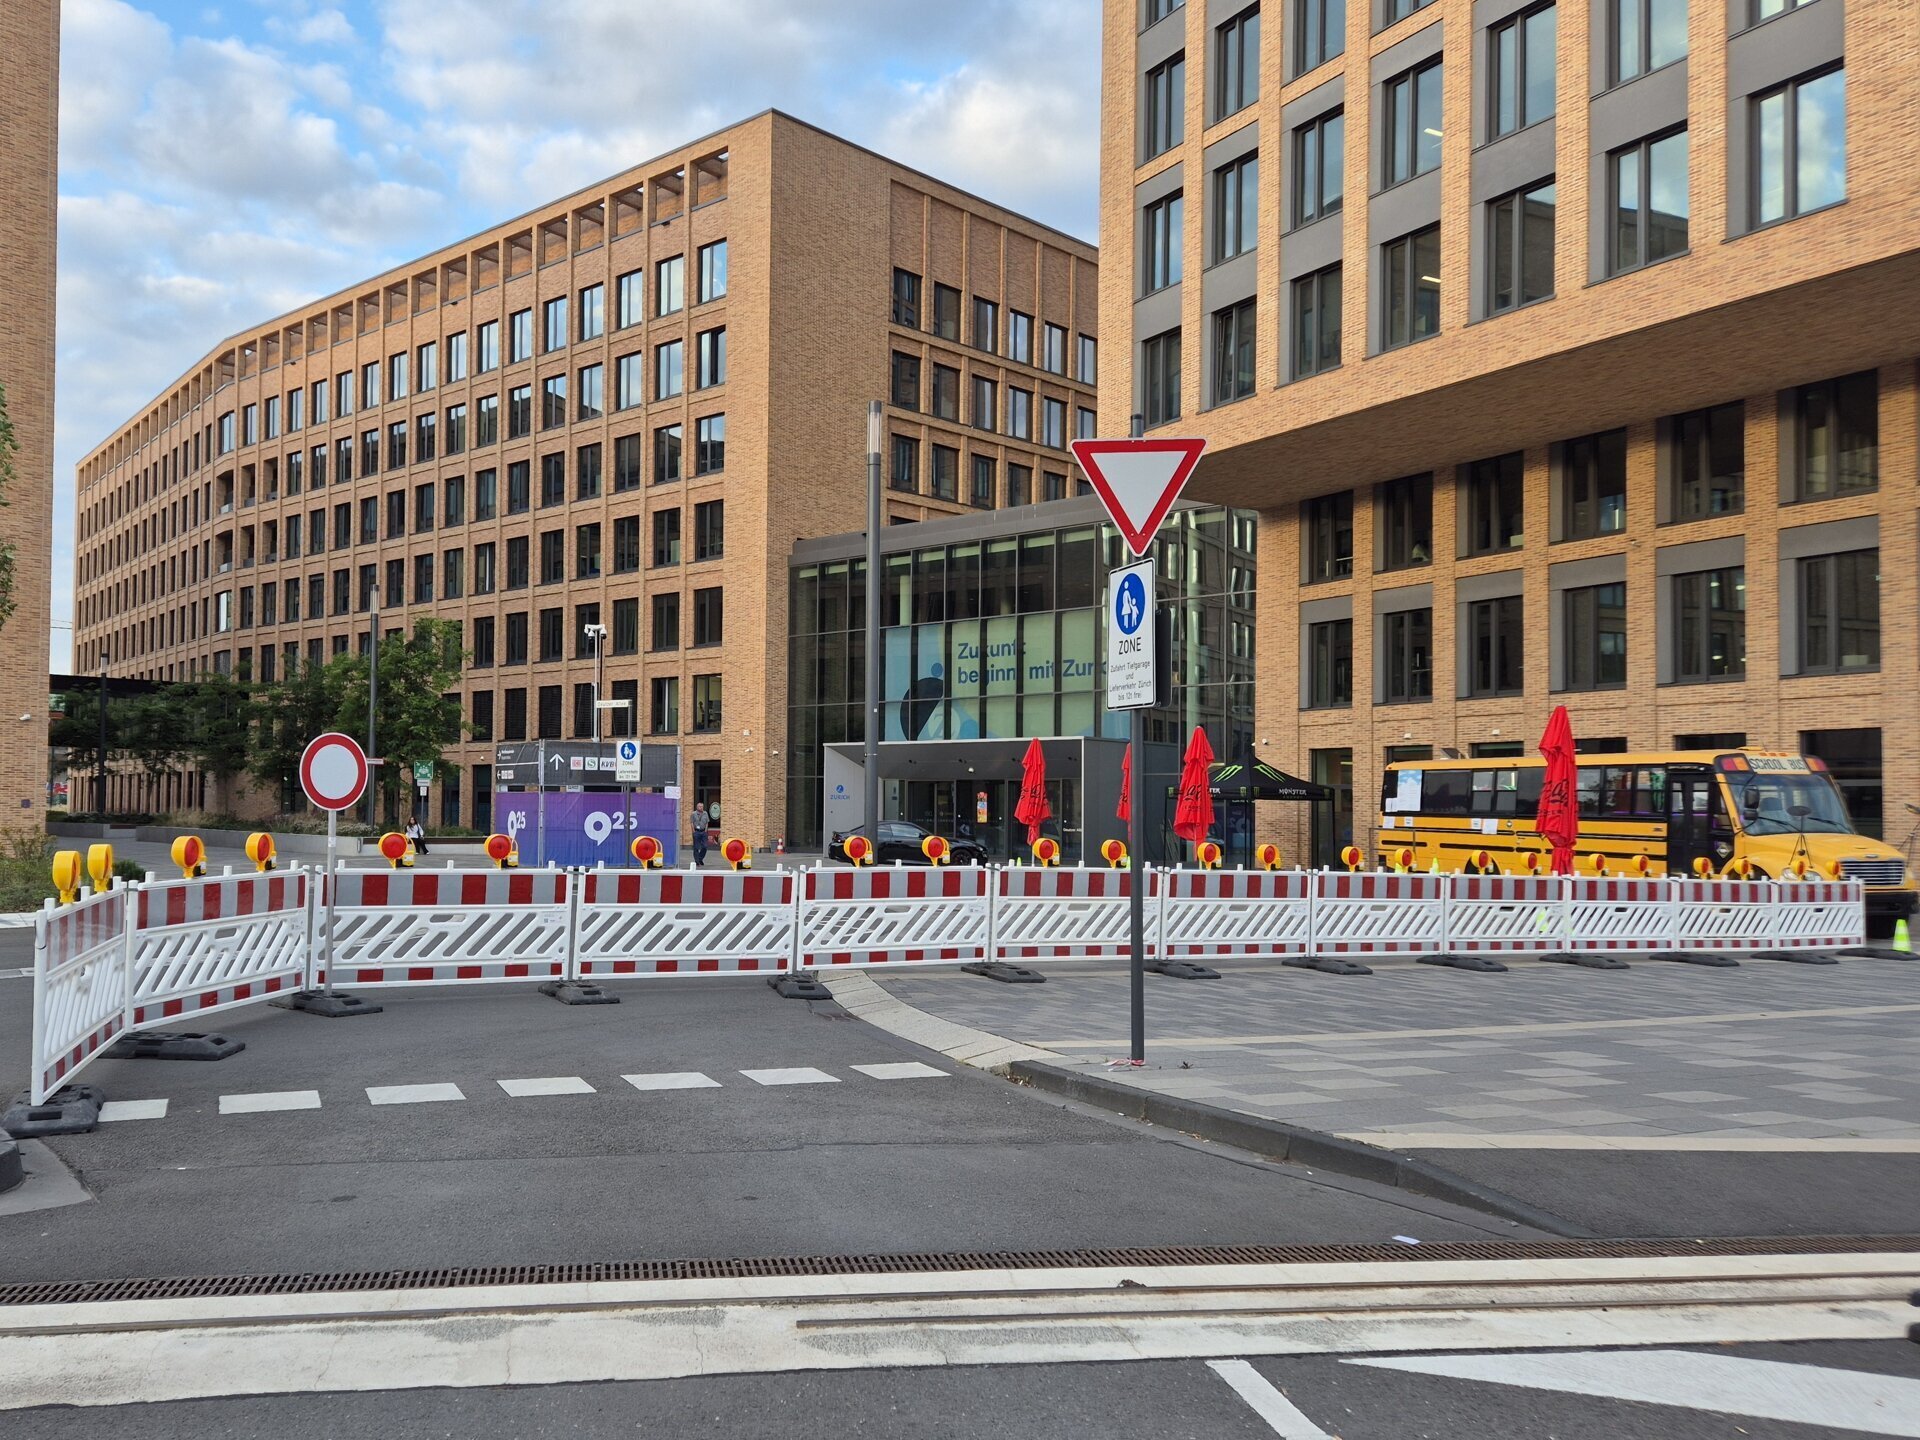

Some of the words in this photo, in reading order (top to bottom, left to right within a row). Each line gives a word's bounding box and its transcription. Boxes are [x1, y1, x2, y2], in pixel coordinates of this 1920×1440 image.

[1119, 637, 1142, 655] ZONE
[958, 664, 1017, 687] beinn
[1126, 672, 1134, 680] und
[1749, 759, 1787, 770] SCHOOL
[1787, 759, 1808, 770] BUS
[1279, 788, 1306, 796] MONSTER
